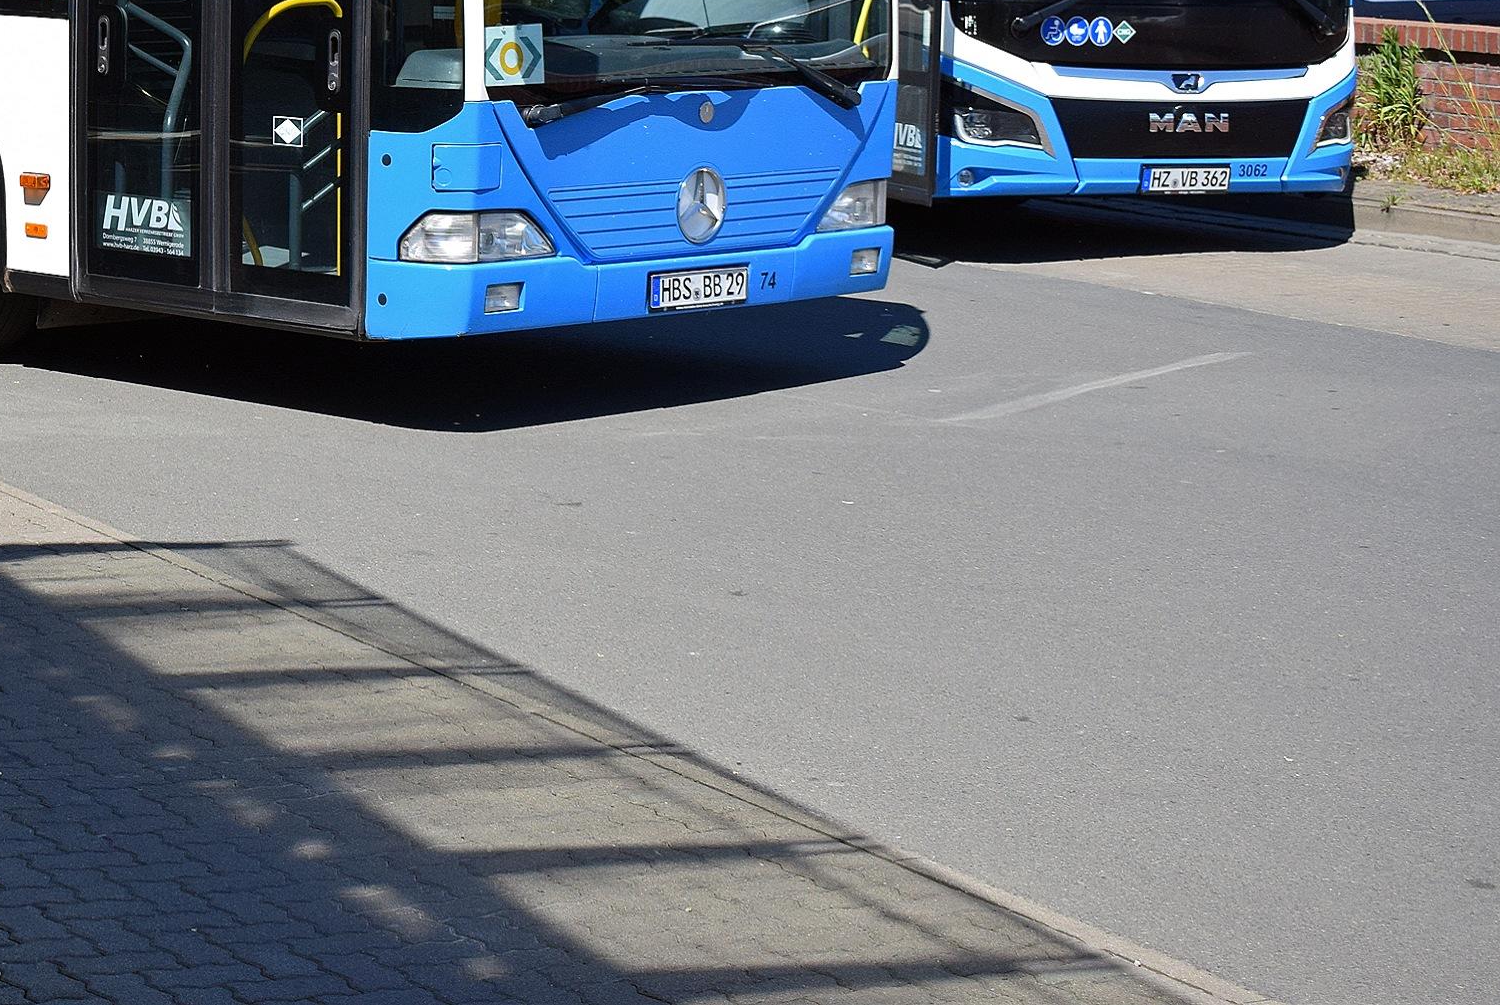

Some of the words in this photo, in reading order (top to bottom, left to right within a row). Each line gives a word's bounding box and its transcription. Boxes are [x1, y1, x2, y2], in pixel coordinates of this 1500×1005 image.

[1149, 112, 1229, 132] MAN
[1151, 171, 1171, 188] HZ
[1181, 170, 1198, 187] VB
[1201, 170, 1228, 187] 362
[1239, 164, 1268, 177] 3062
[102, 194, 169, 231] HVB
[102, 242, 140, 251] www.hvb-harz.de
[156, 239, 184, 249] Wernigerode
[661, 277, 692, 302] HBS
[703, 274, 722, 298] BB
[726, 273, 744, 296] 29
[760, 272, 777, 289] 74
